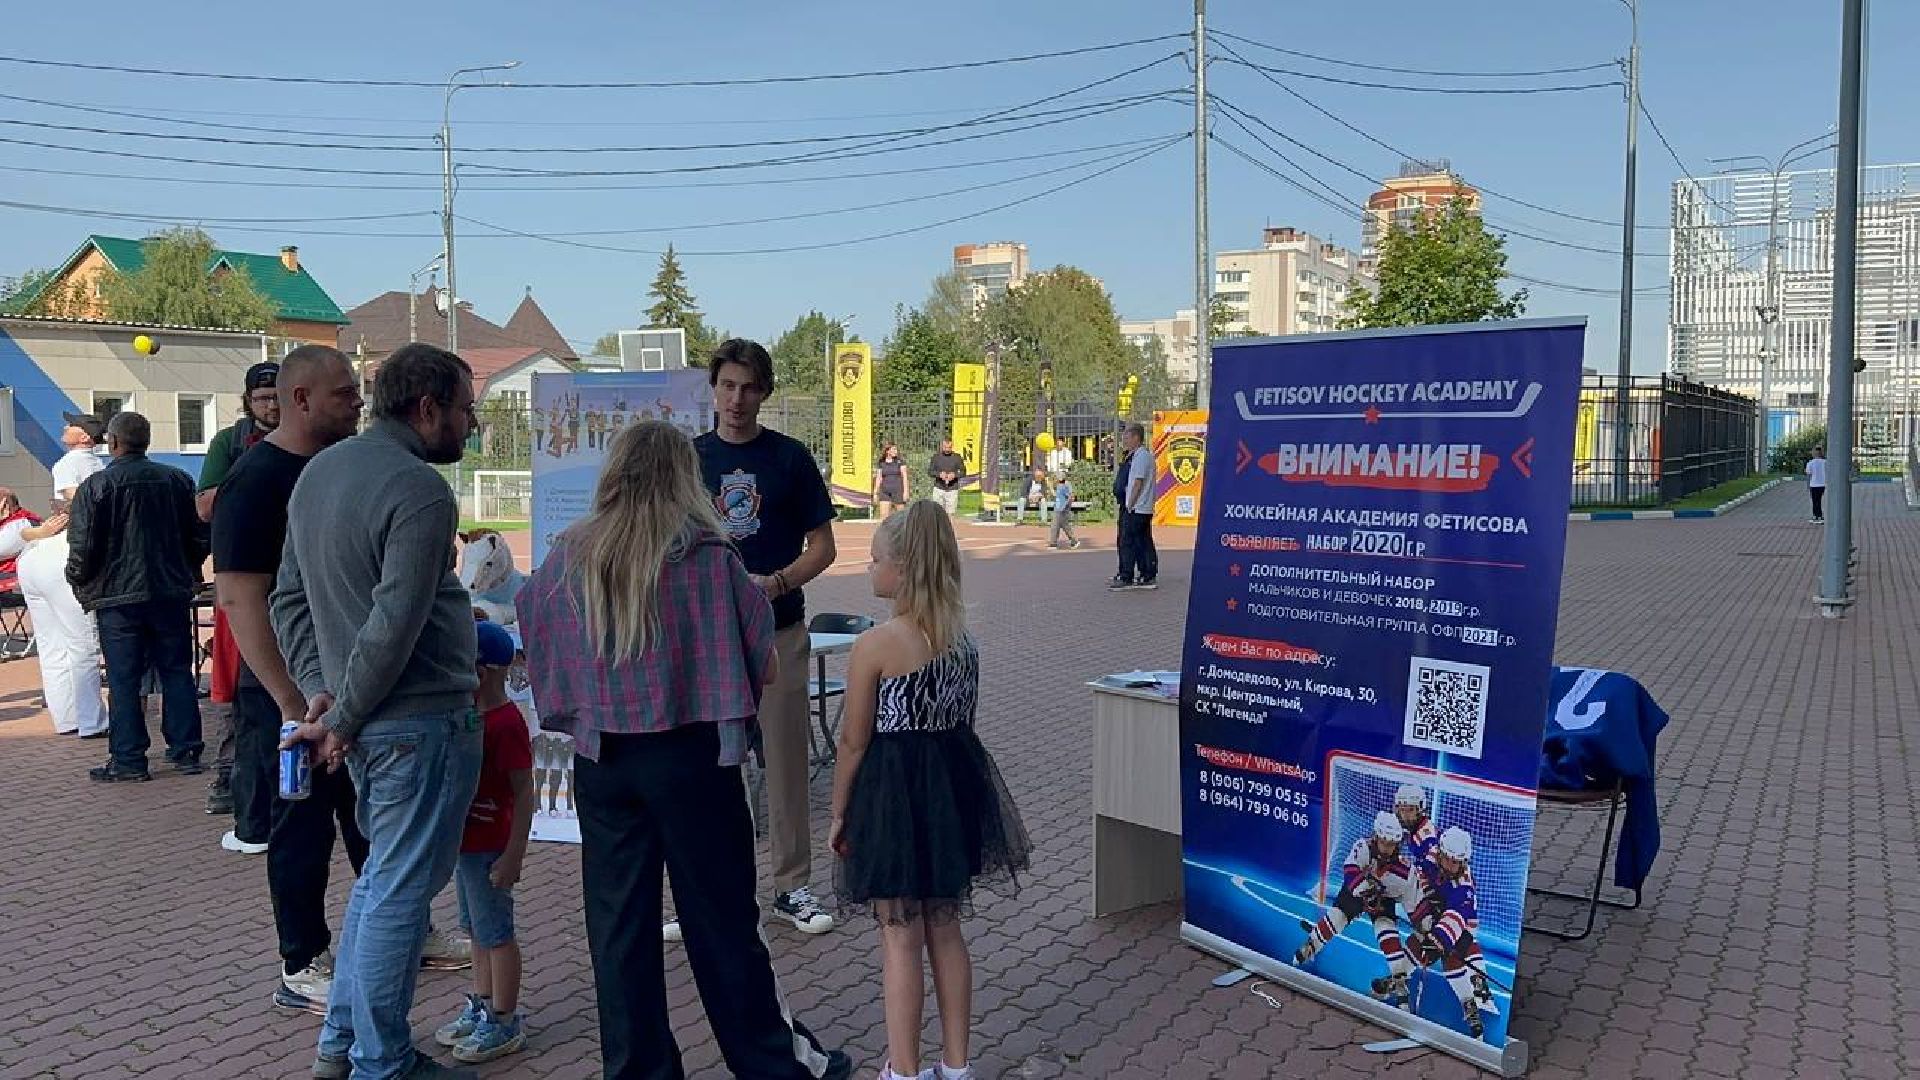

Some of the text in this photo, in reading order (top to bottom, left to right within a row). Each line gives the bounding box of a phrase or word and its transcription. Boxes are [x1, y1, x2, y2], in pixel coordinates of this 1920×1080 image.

[1254, 380, 1518, 406] FETISOV HOCKEY ACADEMY
[842, 401, 855, 475] ДОМОДЕДОВО
[1277, 443, 1481, 479] ВНИМАНИЕ!
[1224, 503, 1528, 534] ХОККЕЙНАЯ АКАДЕМИЯ ФЕТИСОВА
[1306, 534, 1348, 551] НАБОР
[1352, 532, 1403, 555] 2020
[1250, 564, 1435, 591] ДОПОЛНИТЕЛЬНЫЙ НАБОР
[1248, 582, 1320, 599] МАЛЬЧИКОВ
[1323, 589, 1331, 600] И
[1333, 590, 1392, 607] ДЕВОЧЕК
[1247, 603, 1375, 628] ПОДГОТОВИТЕЛЬНАЯ
[1378, 617, 1428, 635] ГРУППА
[1201, 635, 1336, 669] Ждем Вас по адресу:
[1223, 685, 1303, 712] Центральный,
[1284, 678, 1302, 692] ул.
[1305, 678, 1354, 701] Кирова,
[1195, 700, 1210, 715] СК
[1194, 743, 1243, 764] Телефон
[1254, 755, 1317, 784] WhatsApp
[1200, 770, 1308, 808] 8 (906) 799 05 55
[1199, 789, 1308, 828] 8 (964) 799 06 06
